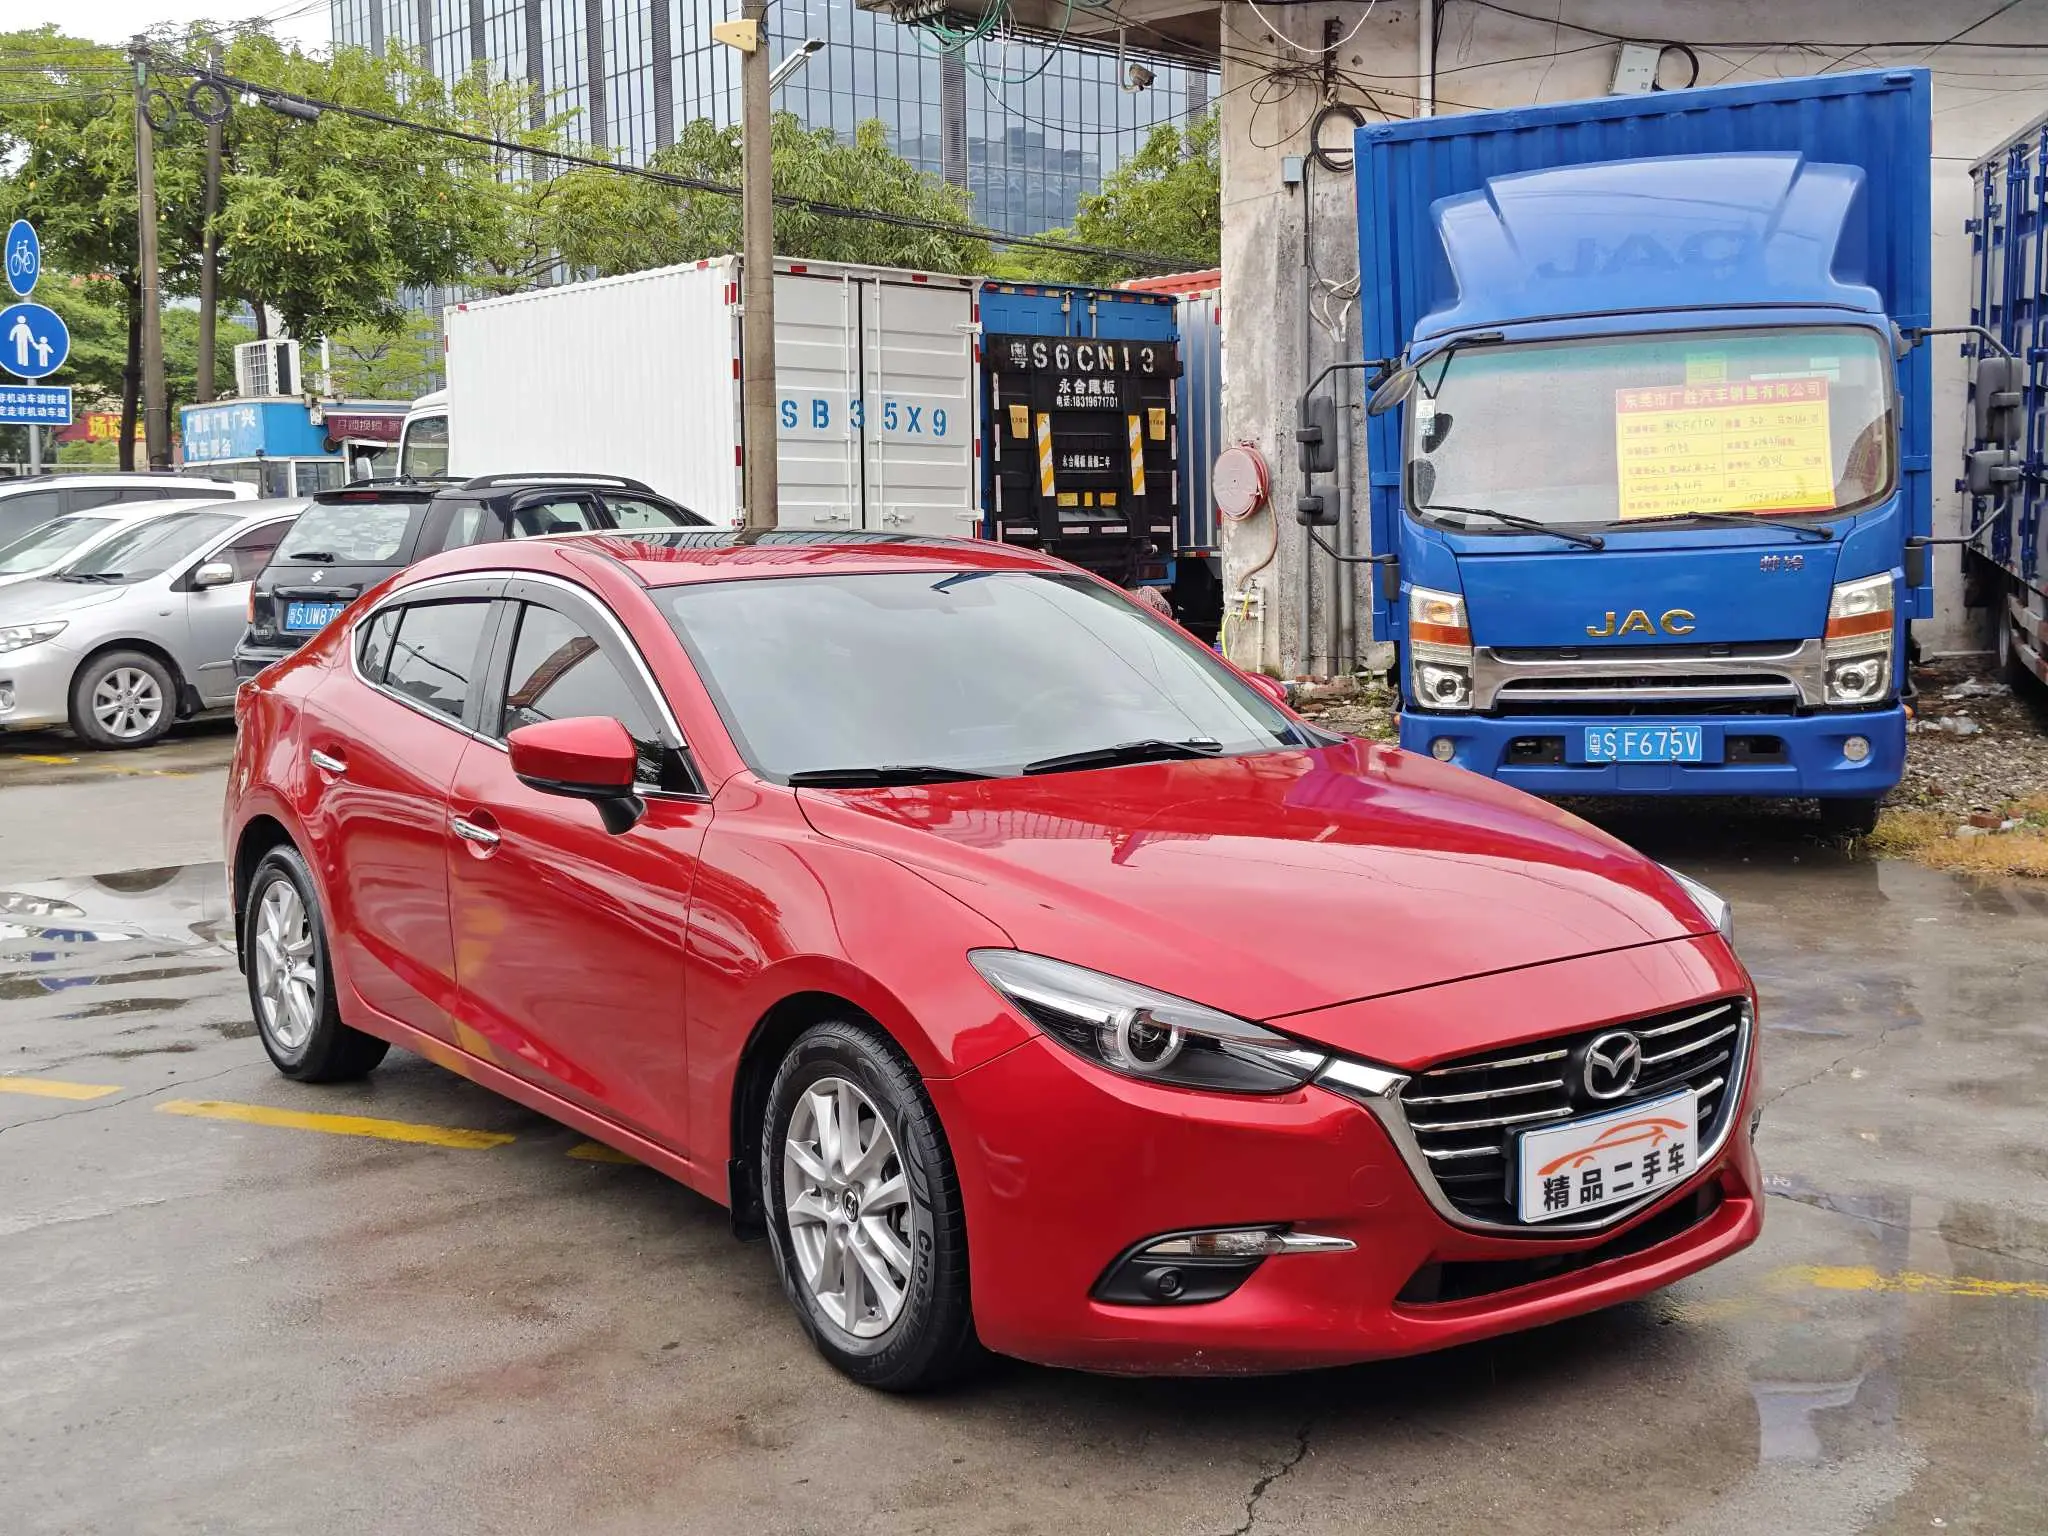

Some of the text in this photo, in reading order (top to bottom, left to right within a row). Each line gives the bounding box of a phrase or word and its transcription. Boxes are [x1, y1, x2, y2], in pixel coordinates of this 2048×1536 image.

[1536, 228, 1756, 279] JAC
[1058, 378, 1116, 395] 永合尾板
[1586, 608, 1697, 638] JAC
[1542, 1142, 1686, 1213] 精品二手车
